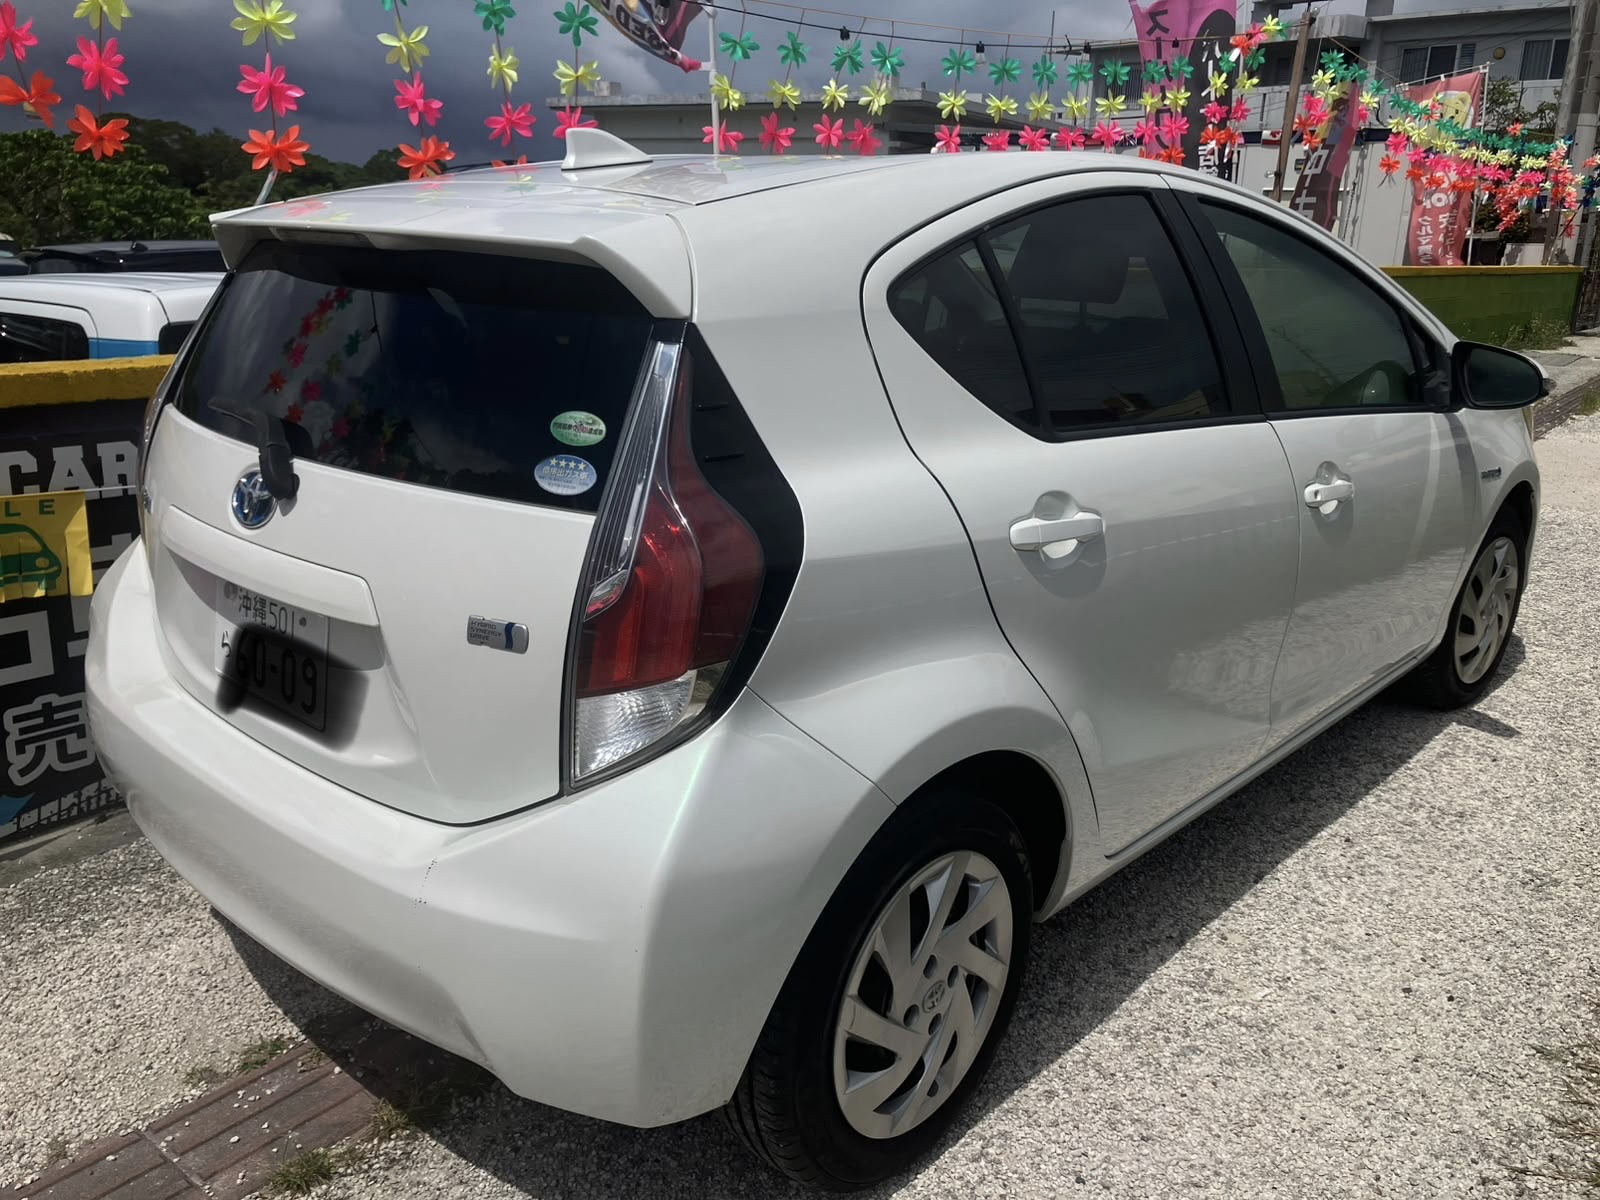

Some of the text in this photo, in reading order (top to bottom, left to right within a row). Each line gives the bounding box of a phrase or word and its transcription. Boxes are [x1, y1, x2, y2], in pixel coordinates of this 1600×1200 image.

[0, 441, 138, 500] CAR
[471, 620, 497, 630] HYBRID
[470, 627, 502, 637] SYNERGY
[470, 632, 491, 640] DRIVE
